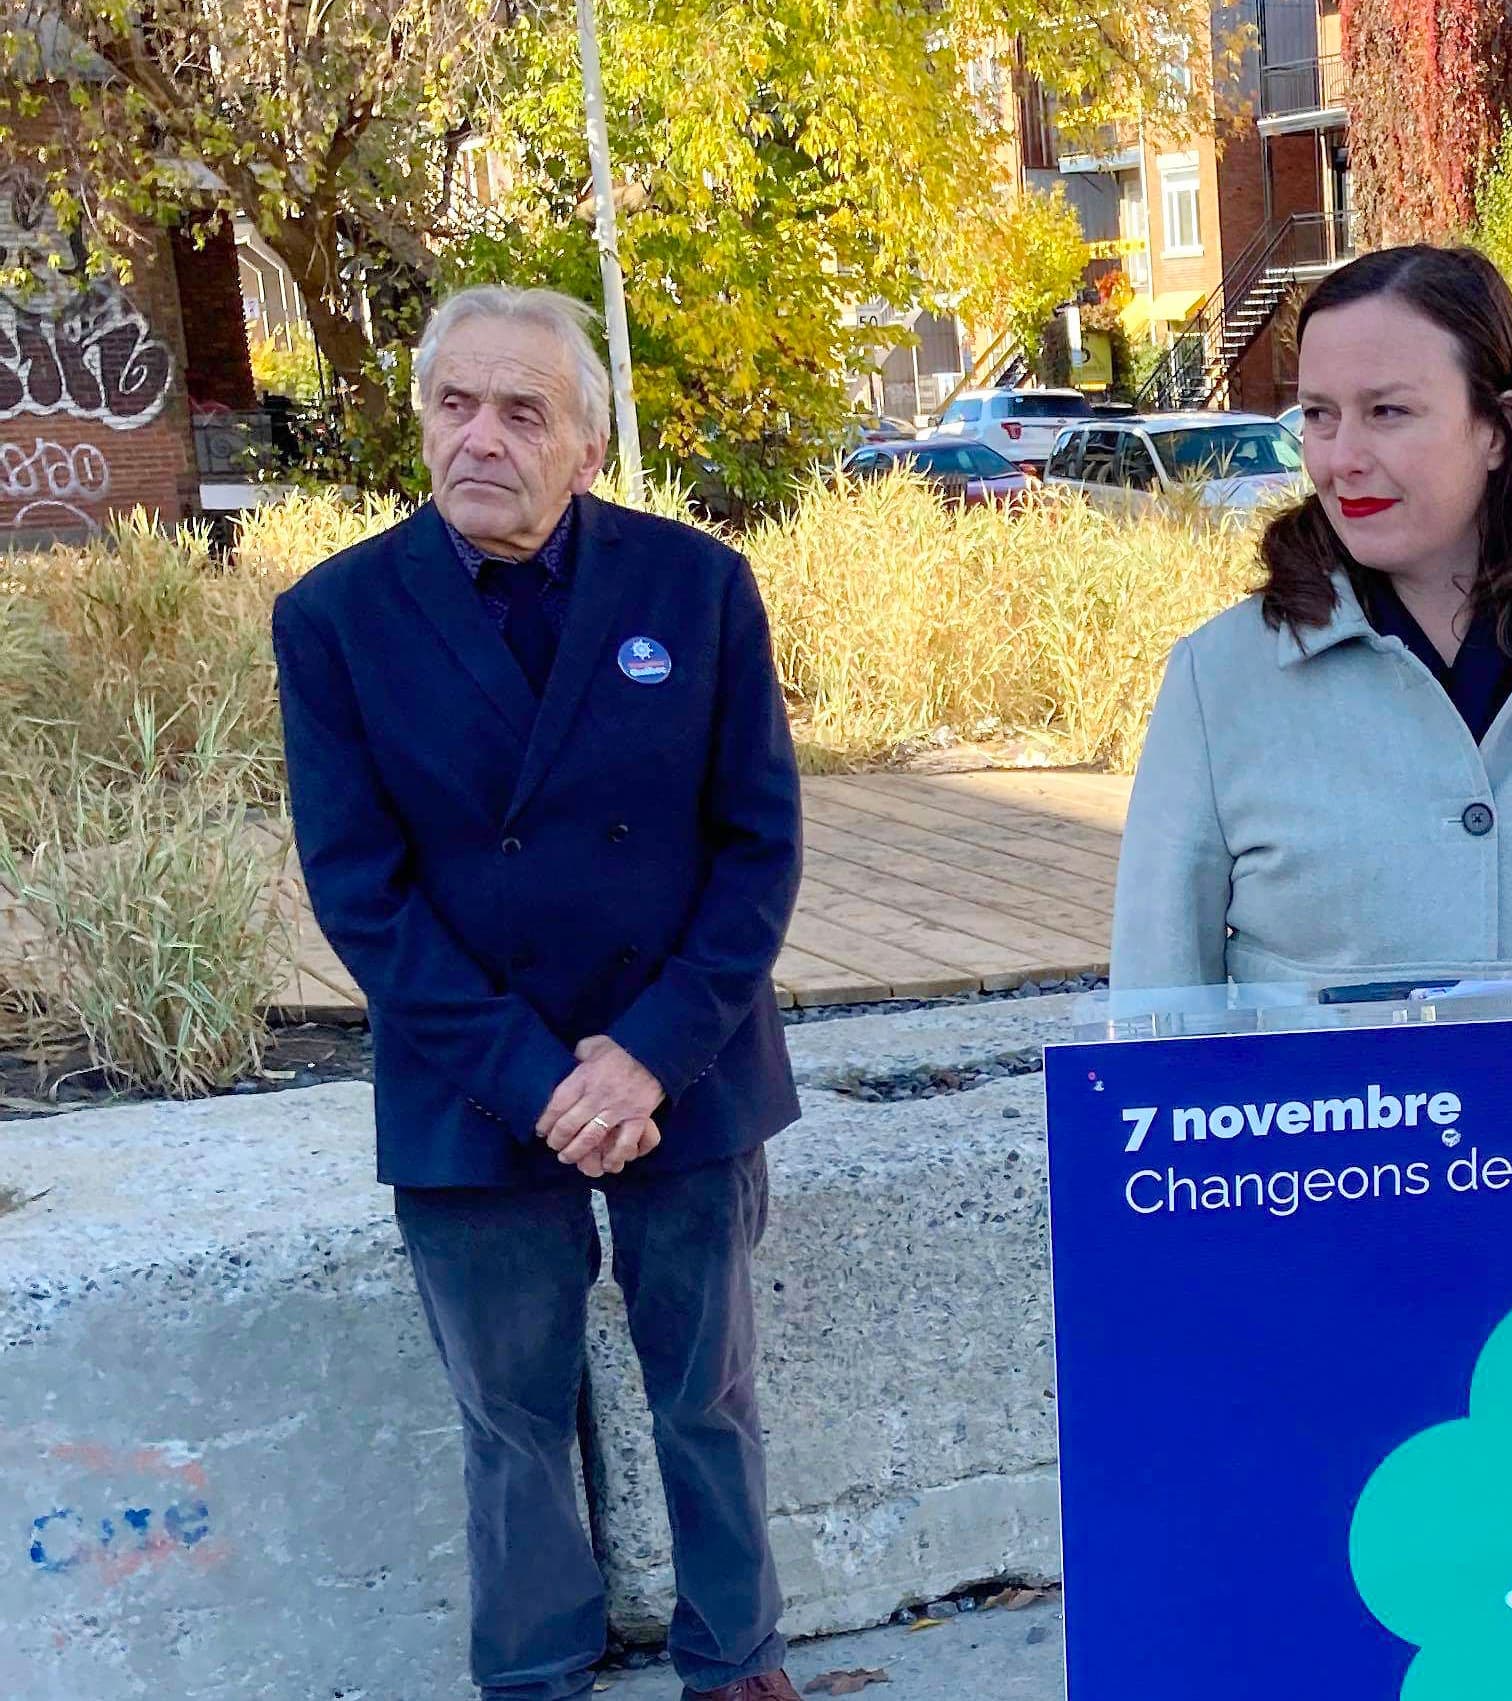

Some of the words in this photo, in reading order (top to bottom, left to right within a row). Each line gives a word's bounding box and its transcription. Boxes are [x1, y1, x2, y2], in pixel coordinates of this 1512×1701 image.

[1121, 1106, 1158, 1152] 7
[1172, 1084, 1463, 1142] novembre
[1124, 1158, 1430, 1217] Changeons
[1446, 1147, 1512, 1192] de
